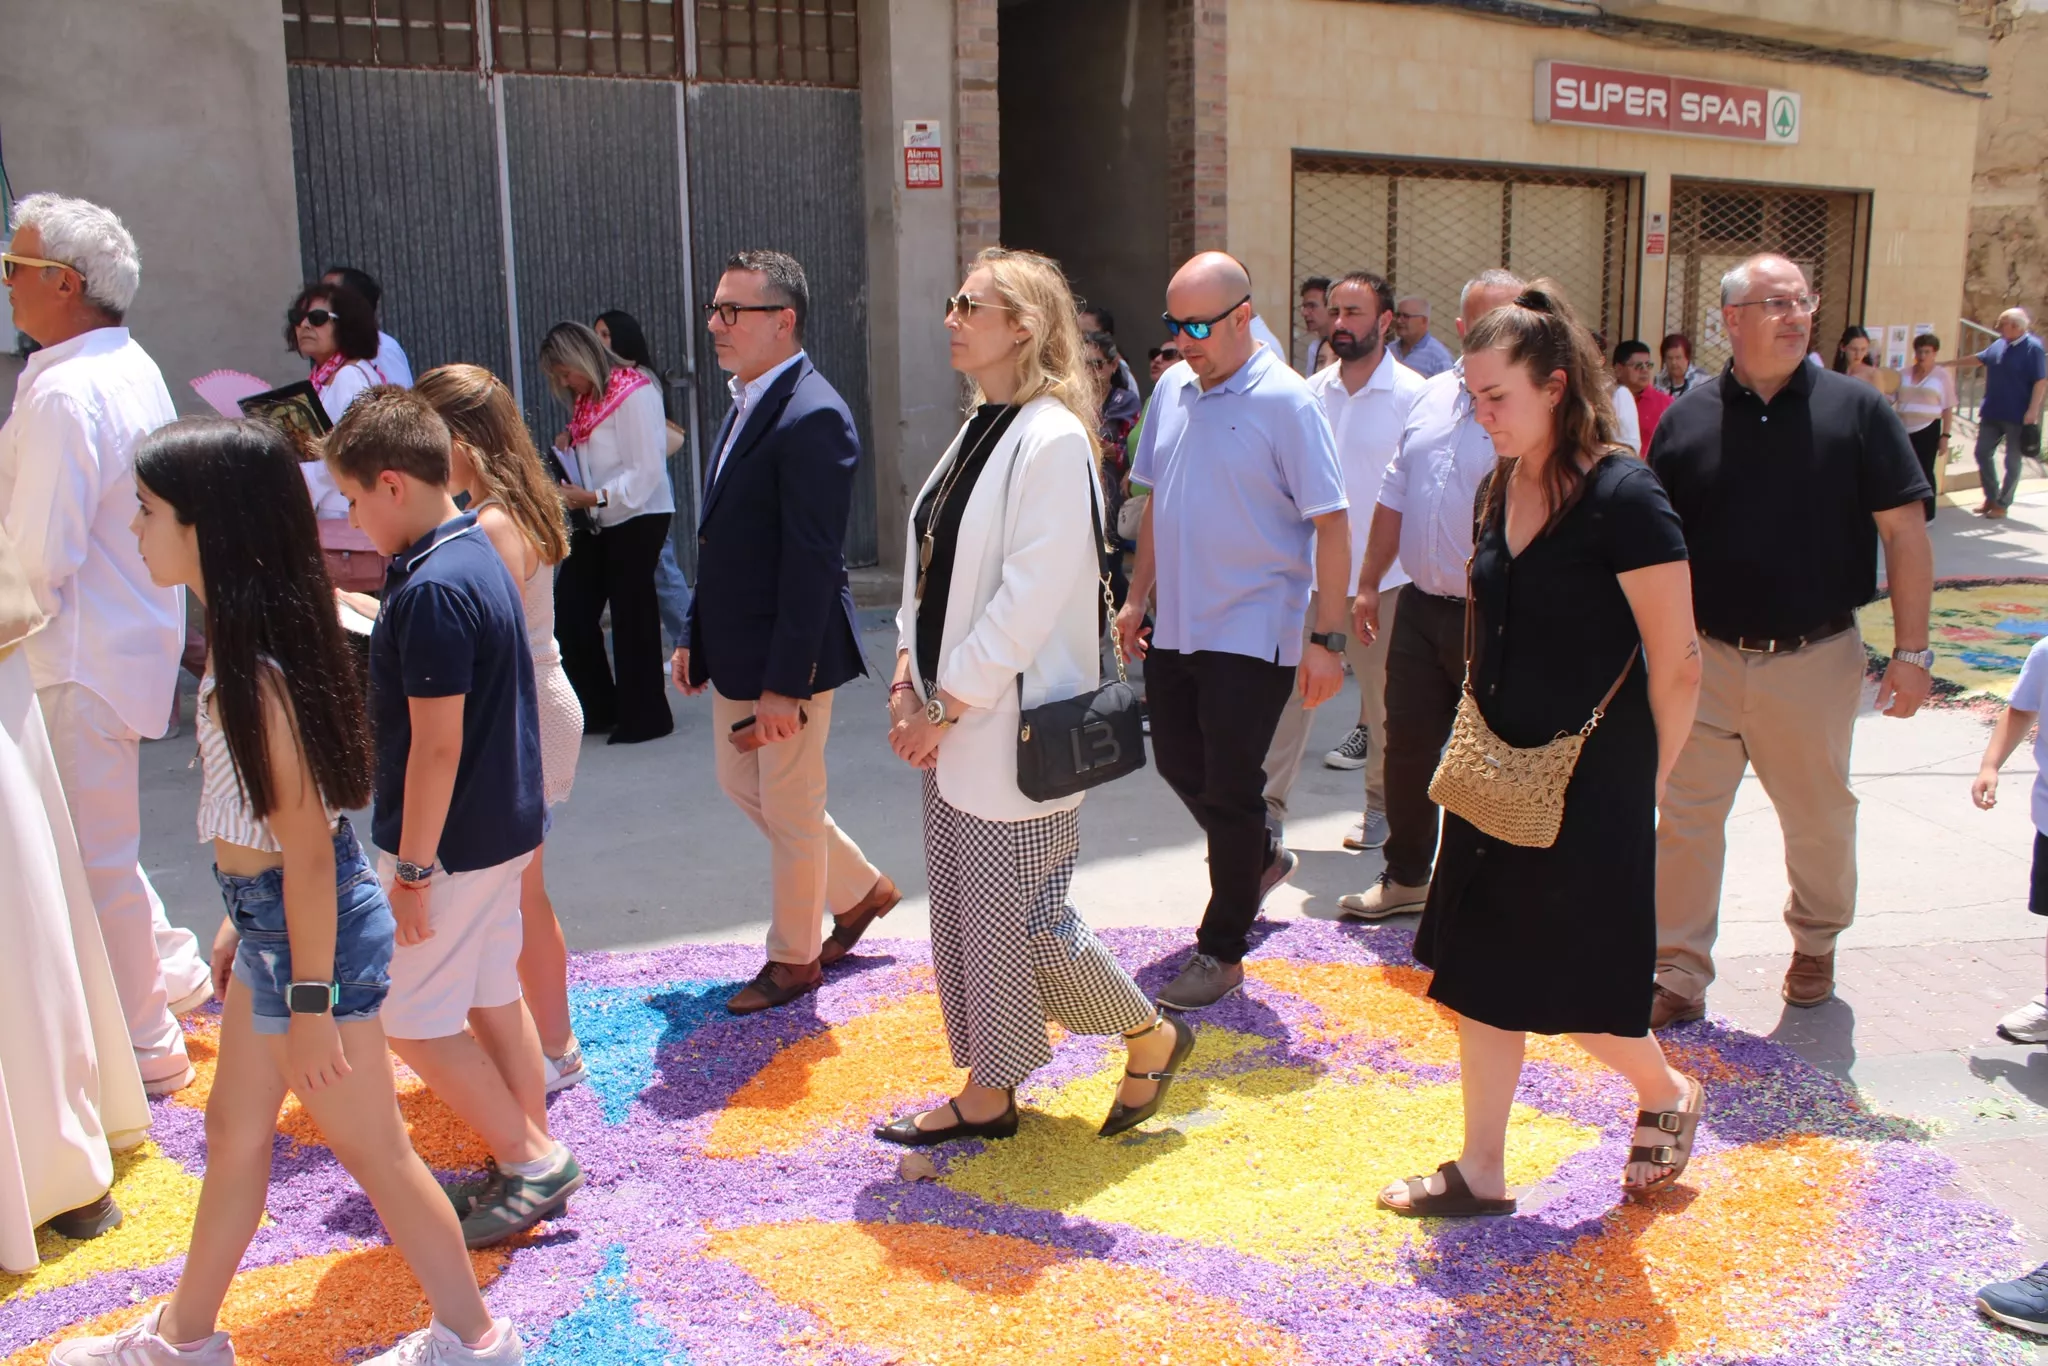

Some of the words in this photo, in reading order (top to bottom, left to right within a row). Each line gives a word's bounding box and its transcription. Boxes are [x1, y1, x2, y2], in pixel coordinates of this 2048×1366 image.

[1555, 77, 1667, 118] SUPER
[1680, 92, 1761, 128] SPAR
[907, 148, 938, 159] Alarma
